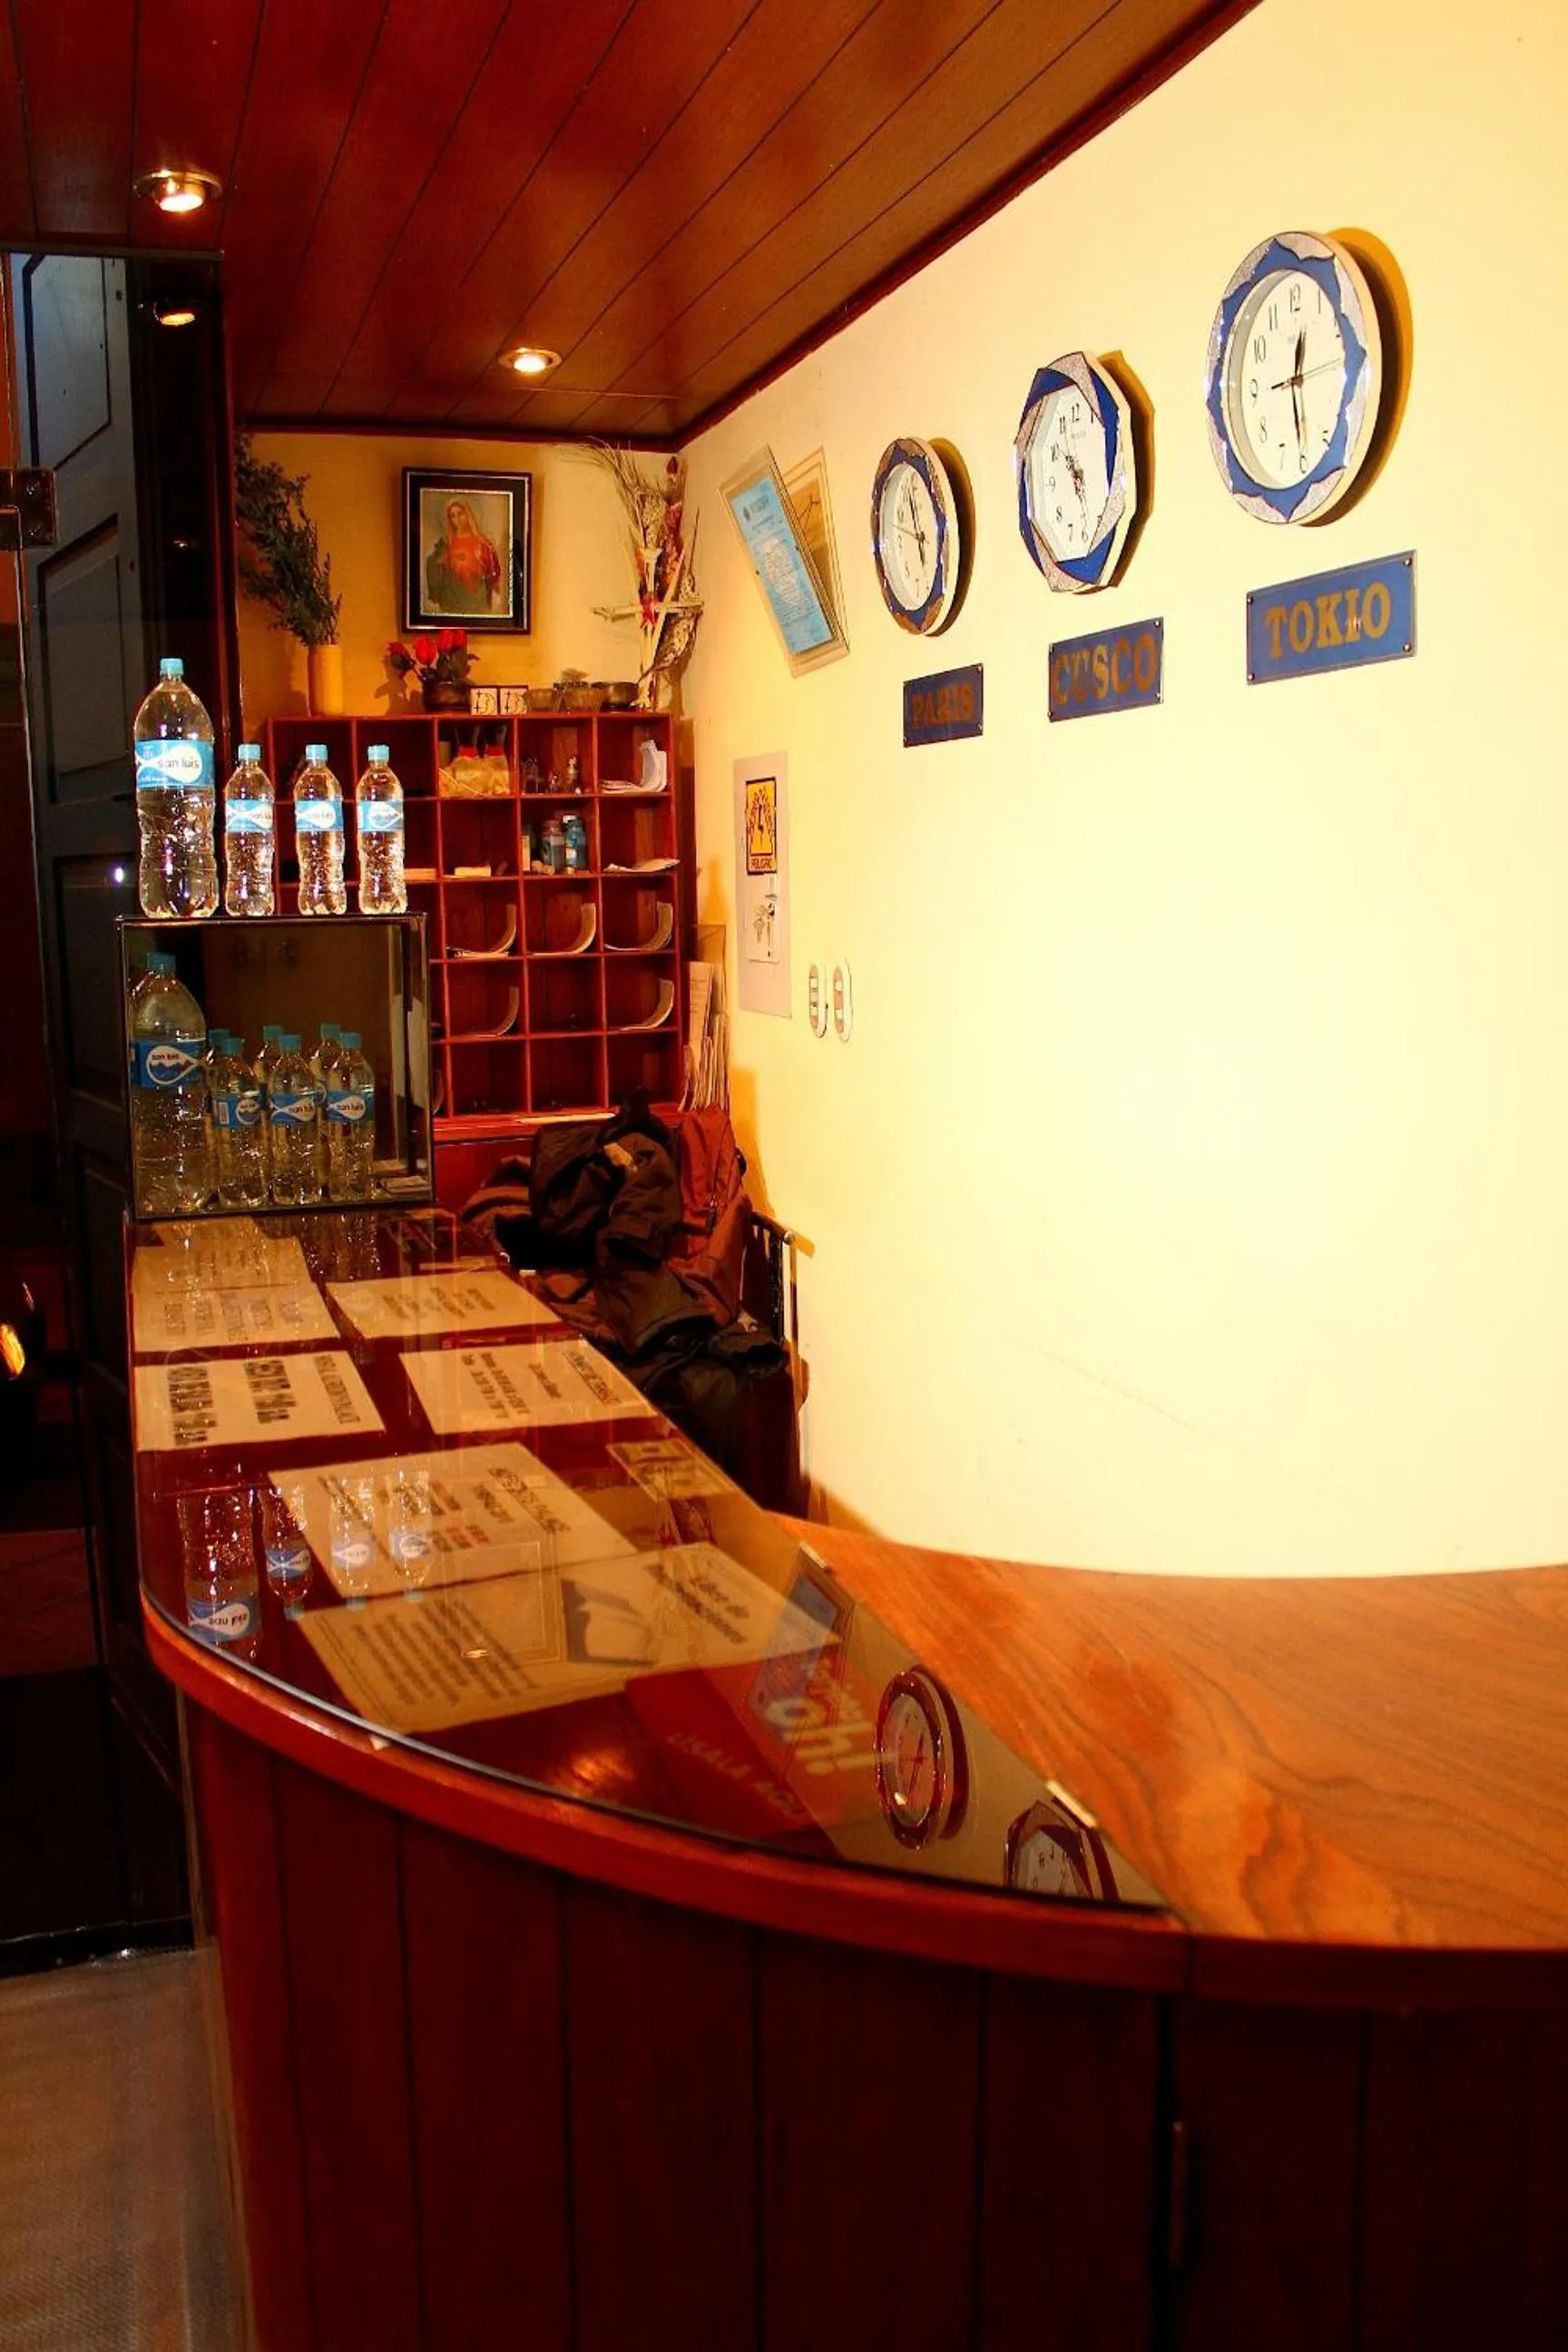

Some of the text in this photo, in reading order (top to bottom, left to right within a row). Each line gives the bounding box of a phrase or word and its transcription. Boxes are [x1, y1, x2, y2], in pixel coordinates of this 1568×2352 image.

[1289, 283, 1301, 314] 12
[1269, 302, 1279, 332] 11
[1253, 335, 1267, 364] 10
[1264, 581, 1391, 660] TOKIO
[1053, 633, 1157, 706] CUSCO
[158, 757, 200, 769] san luis
